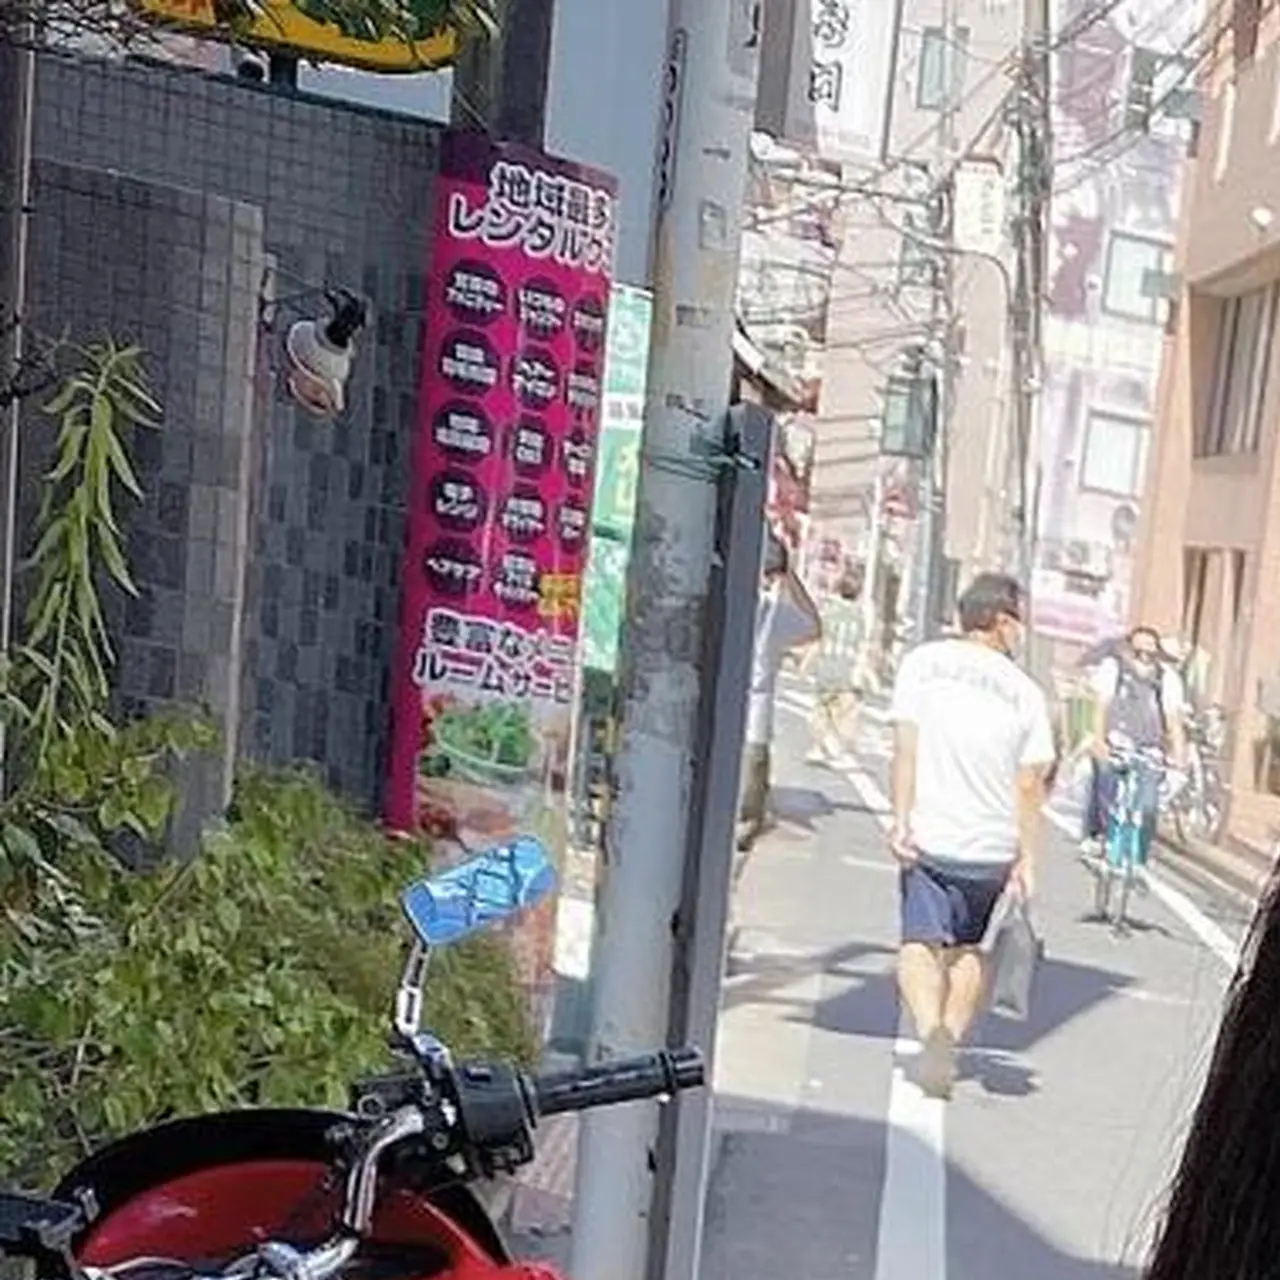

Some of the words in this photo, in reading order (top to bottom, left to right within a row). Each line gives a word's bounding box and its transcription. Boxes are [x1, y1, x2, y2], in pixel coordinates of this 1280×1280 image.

[449, 192, 613, 278] レンタルグ
